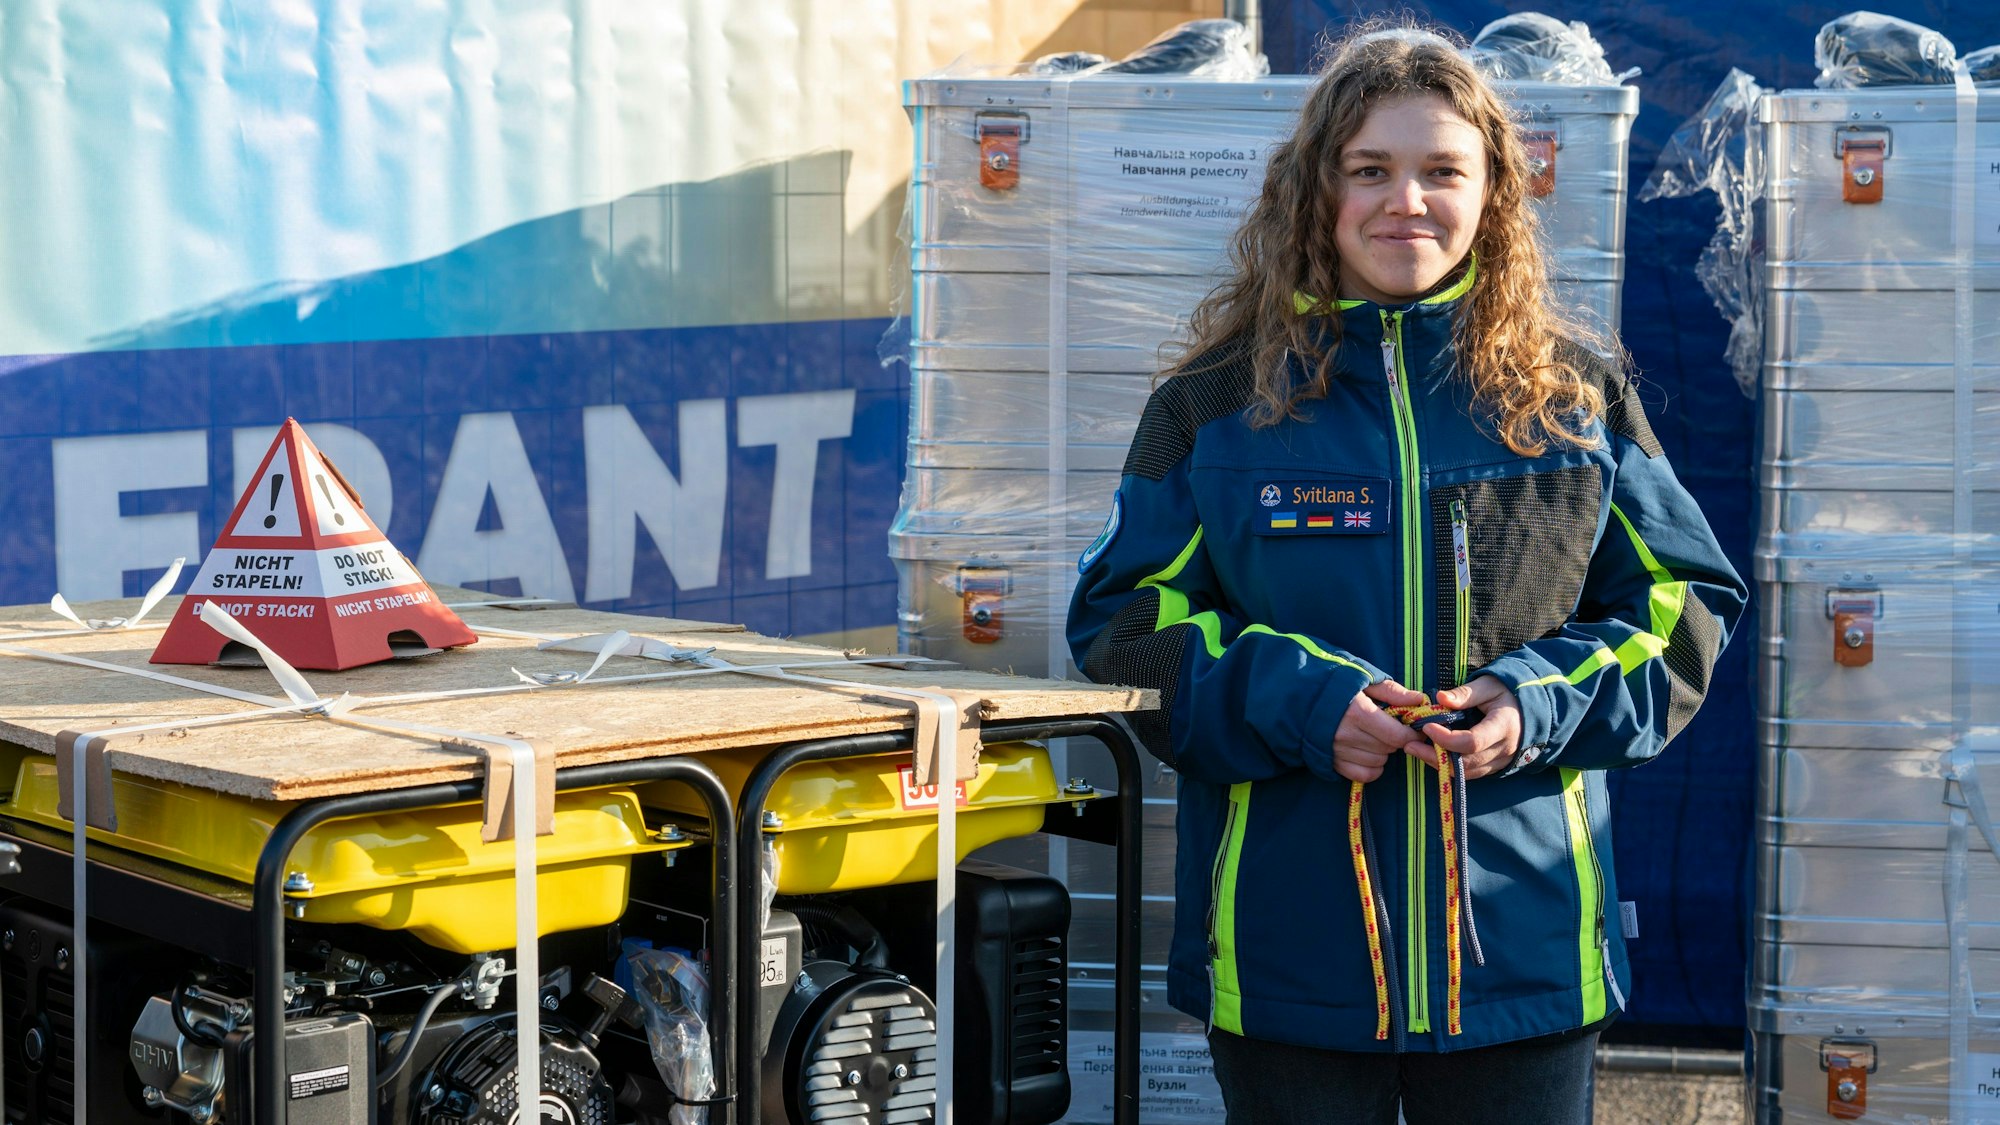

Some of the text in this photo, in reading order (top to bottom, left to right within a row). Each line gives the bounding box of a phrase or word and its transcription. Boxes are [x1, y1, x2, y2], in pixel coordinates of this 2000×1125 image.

[1113, 146, 1257, 162] Навчальна коробка 3
[1122, 163, 1249, 179] Навчання ремеслу
[1223, 196, 1229, 205] 3
[1121, 207, 1193, 218] Handwerkliche
[1292, 486, 1374, 504] Svitlana S.
[235, 556, 294, 570] NICHT
[333, 550, 386, 570] DO NOT
[212, 574, 303, 590] STAPELN!
[344, 567, 395, 587] STACK!
[222, 603, 256, 617] NOT
[256, 604, 315, 618] STACK!
[334, 591, 431, 617] NICHT STAPELN!
[1171, 1047, 1211, 1060] короб
[1148, 1079, 1187, 1093] Вузли
